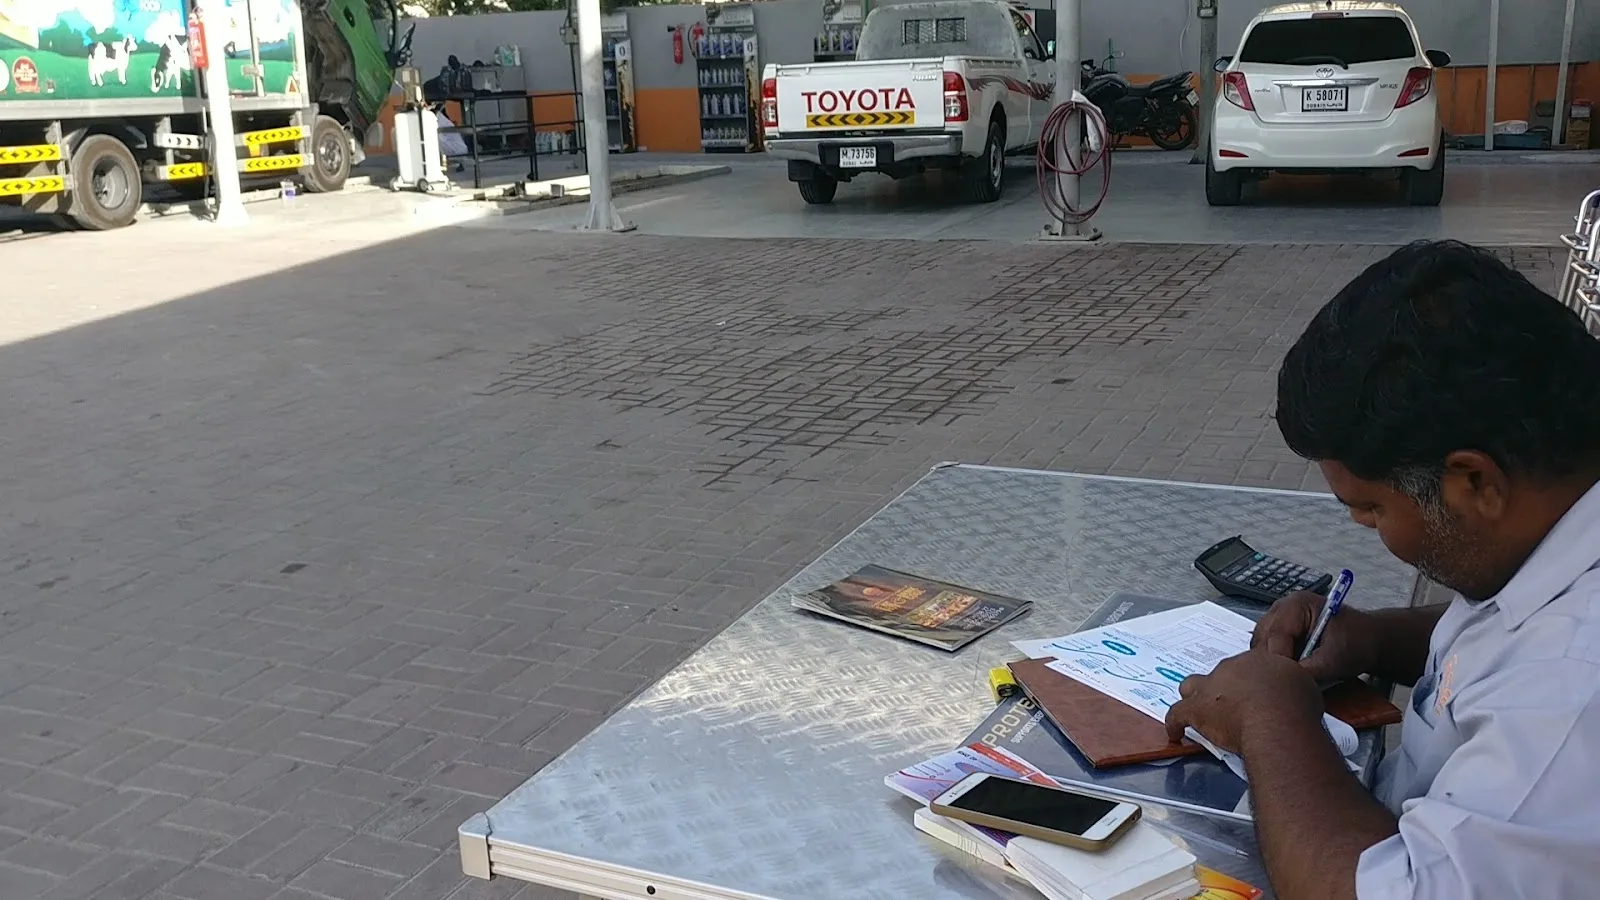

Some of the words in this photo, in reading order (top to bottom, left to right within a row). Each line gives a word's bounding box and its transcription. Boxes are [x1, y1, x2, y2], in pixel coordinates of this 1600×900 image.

[801, 88, 916, 112] TOYOTA
[1306, 90, 1312, 101] K
[1316, 89, 1343, 101] 58071
[841, 150, 848, 159] M
[850, 148, 875, 159] 73756
